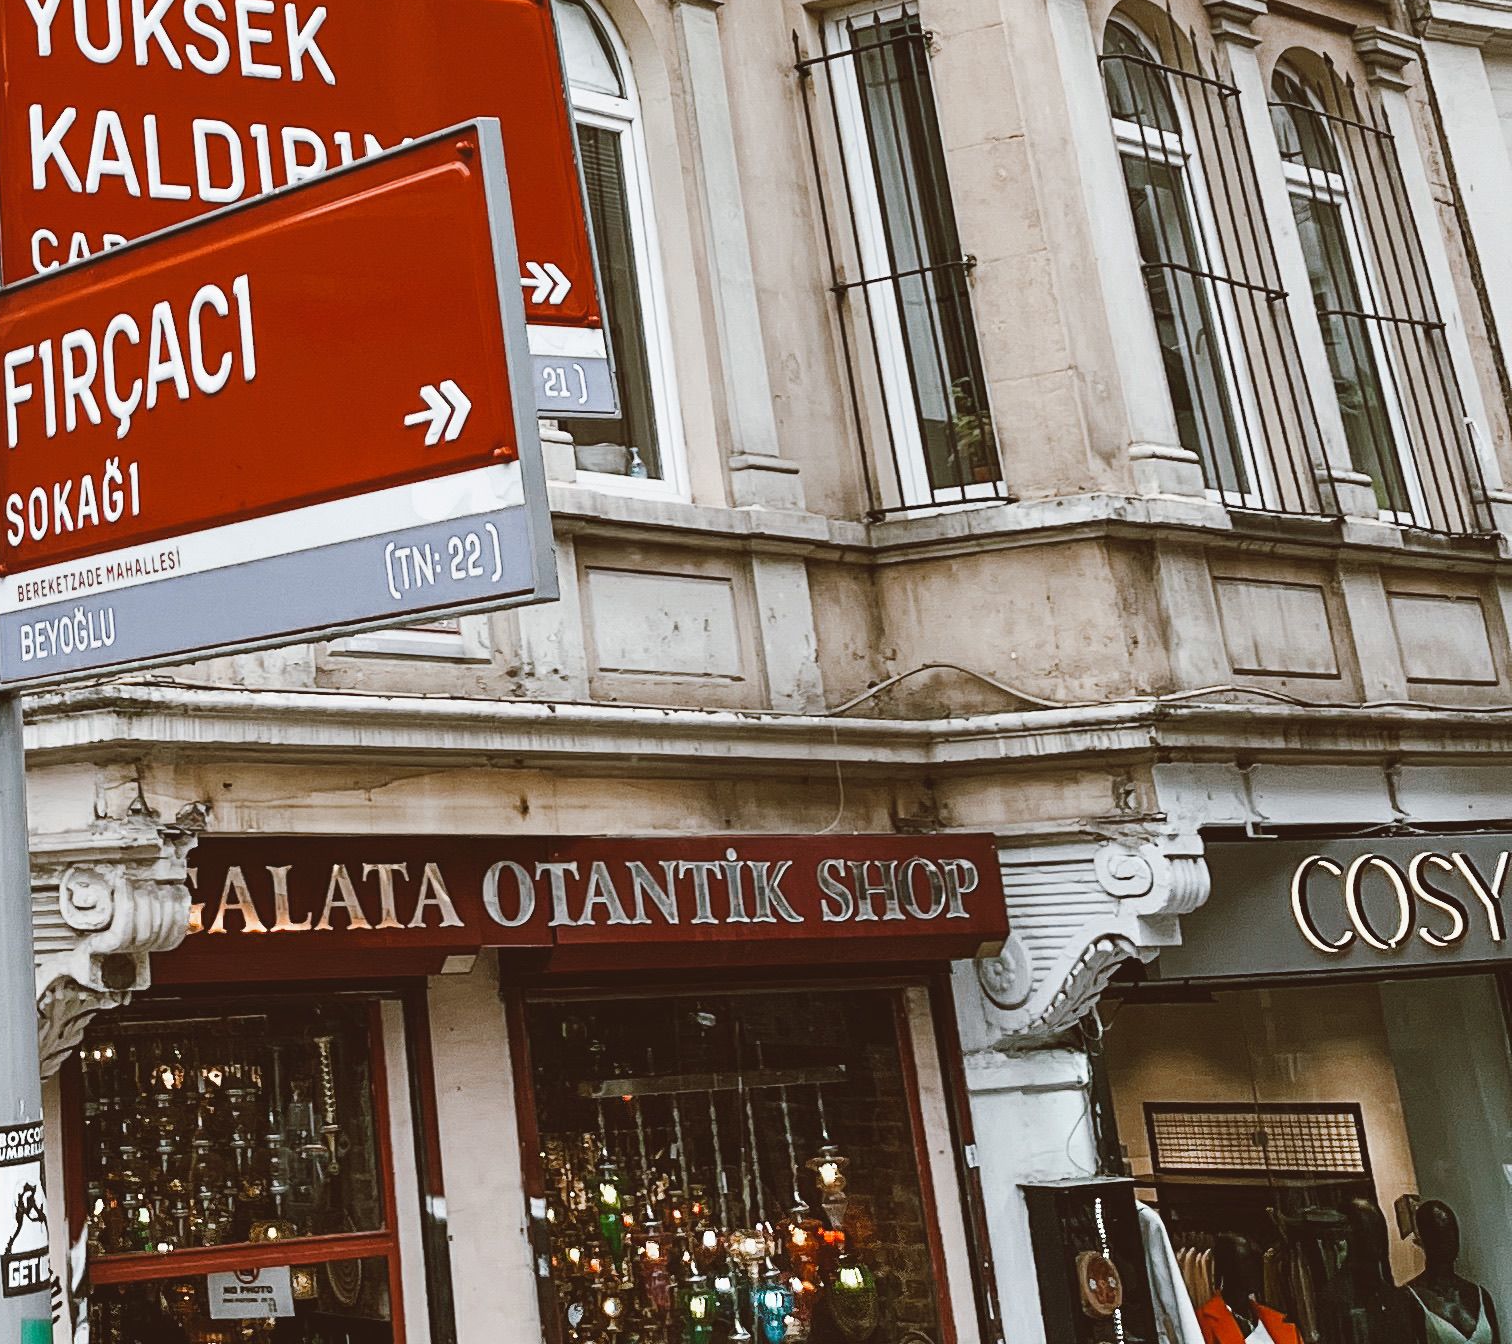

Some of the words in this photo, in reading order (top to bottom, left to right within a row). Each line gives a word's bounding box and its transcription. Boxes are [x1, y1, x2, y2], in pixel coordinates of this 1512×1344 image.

[3, 273, 258, 448] FIRÇACI
[6, 457, 140, 547] SOKAĞI
[17, 565, 104, 603] BEREKETZADE
[106, 550, 182, 584] MAHALLESİ
[20, 607, 116, 662] BEYOĞLU
[481, 847, 805, 928] OTANTİK
[815, 855, 980, 923] SHOP
[7, 1256, 40, 1289] GET
